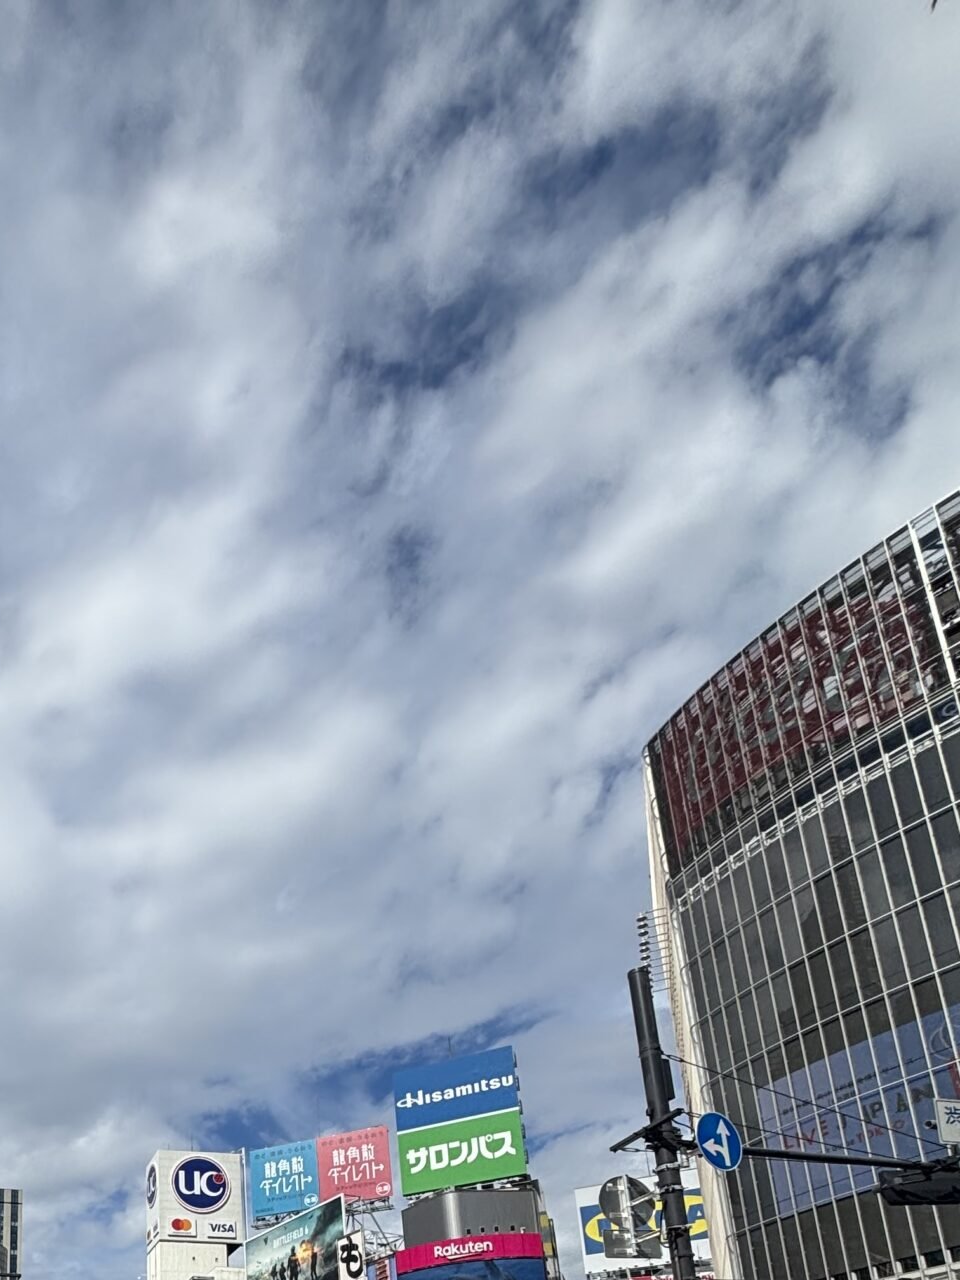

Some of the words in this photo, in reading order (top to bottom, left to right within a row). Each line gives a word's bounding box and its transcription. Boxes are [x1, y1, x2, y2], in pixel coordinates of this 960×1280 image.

[396, 1074, 514, 1108] Hisamitsu
[332, 1143, 375, 1167] 龍角散
[406, 1130, 517, 1174] サロンパス
[263, 1155, 305, 1179] 龍角散
[209, 1223, 235, 1233] VISA
[434, 1241, 493, 1260] Rakuten
